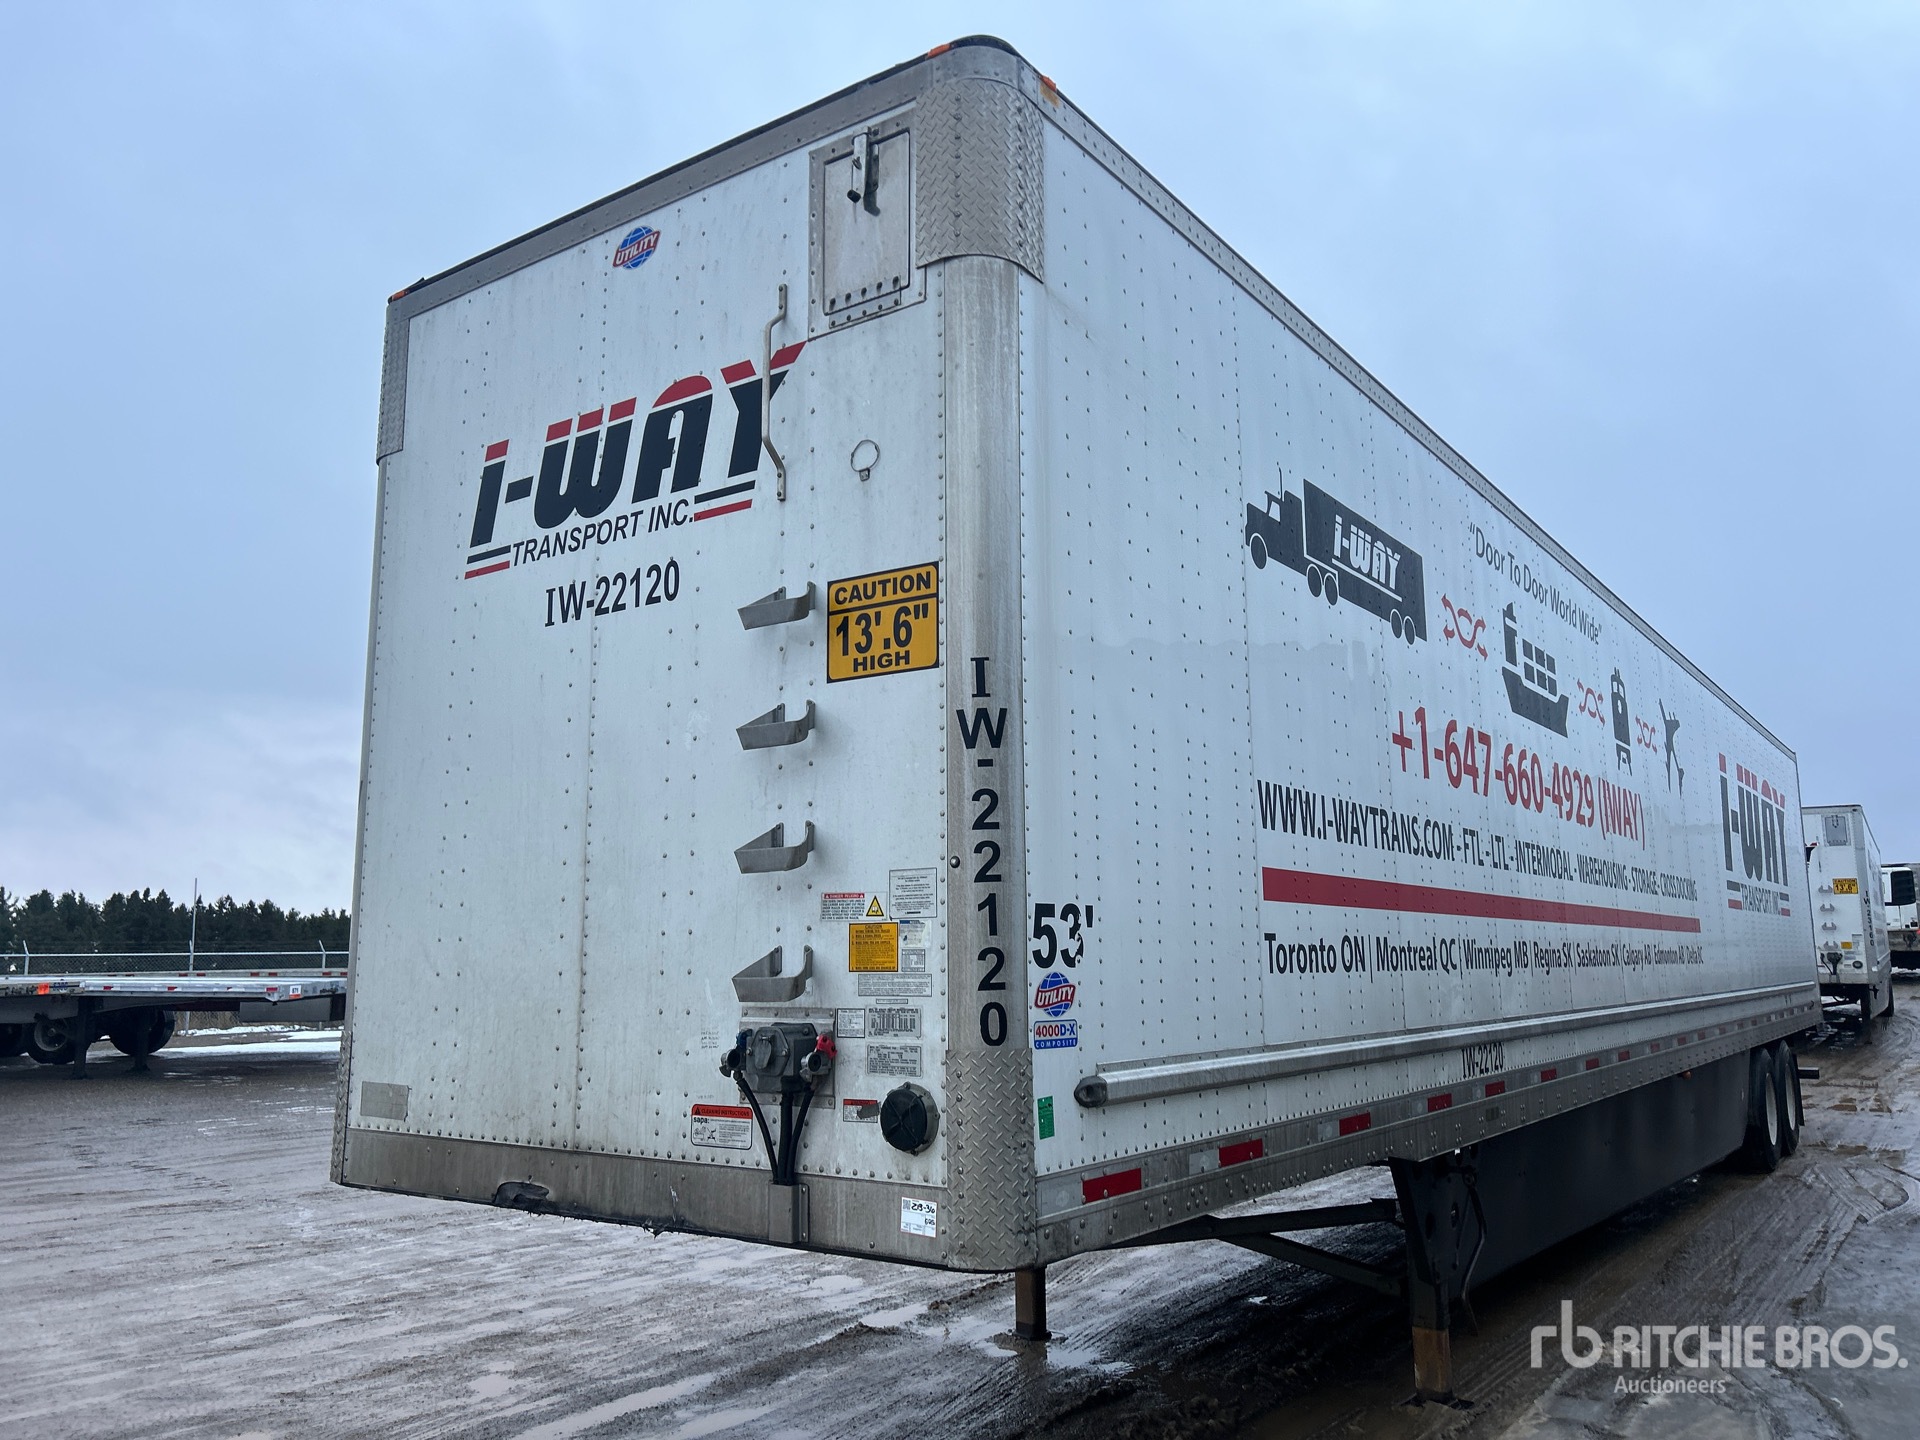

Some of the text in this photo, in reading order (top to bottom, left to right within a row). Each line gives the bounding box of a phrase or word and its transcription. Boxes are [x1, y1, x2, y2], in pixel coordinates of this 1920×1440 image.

[615, 233, 659, 266] UTILITY
[512, 499, 694, 567] TRANSPORT INC.
[544, 559, 680, 628] IW-22120
[834, 571, 931, 605] CAUTION
[1507, 551, 1521, 588] To
[1523, 564, 1549, 607] Door
[1550, 584, 1577, 630] World
[853, 649, 910, 673] HIGH
[1392, 706, 1645, 851] +1-647-660-4929 (IWAY)
[1257, 779, 1456, 862] WWW.I-WAYTRANS.COM
[1462, 827, 1484, 867] FTL
[1491, 834, 1509, 870] LTL
[1515, 839, 1574, 881] INTERMODAL
[1576, 853, 1629, 891] WAREHOUSING
[1631, 866, 1659, 895] STORAGE
[1264, 932, 1337, 974] Toronto
[1341, 934, 1366, 973] ON
[1375, 936, 1438, 972] Montreal
[1439, 937, 1458, 975] QC
[1463, 938, 1513, 978] Winnipeg
[1513, 940, 1529, 969] MB
[1533, 940, 1562, 976] Regina
[1562, 942, 1573, 968] SK
[1576, 942, 1611, 968] Saskatoon
[1611, 943, 1621, 967] SK
[1622, 942, 1644, 972] Calgary
[1037, 986, 1074, 1006] UTILITY
[1035, 1023, 1076, 1038] 4000D-X
[1035, 1039, 1076, 1048] COMPOSITE
[1461, 1041, 1504, 1080] IW-22120
